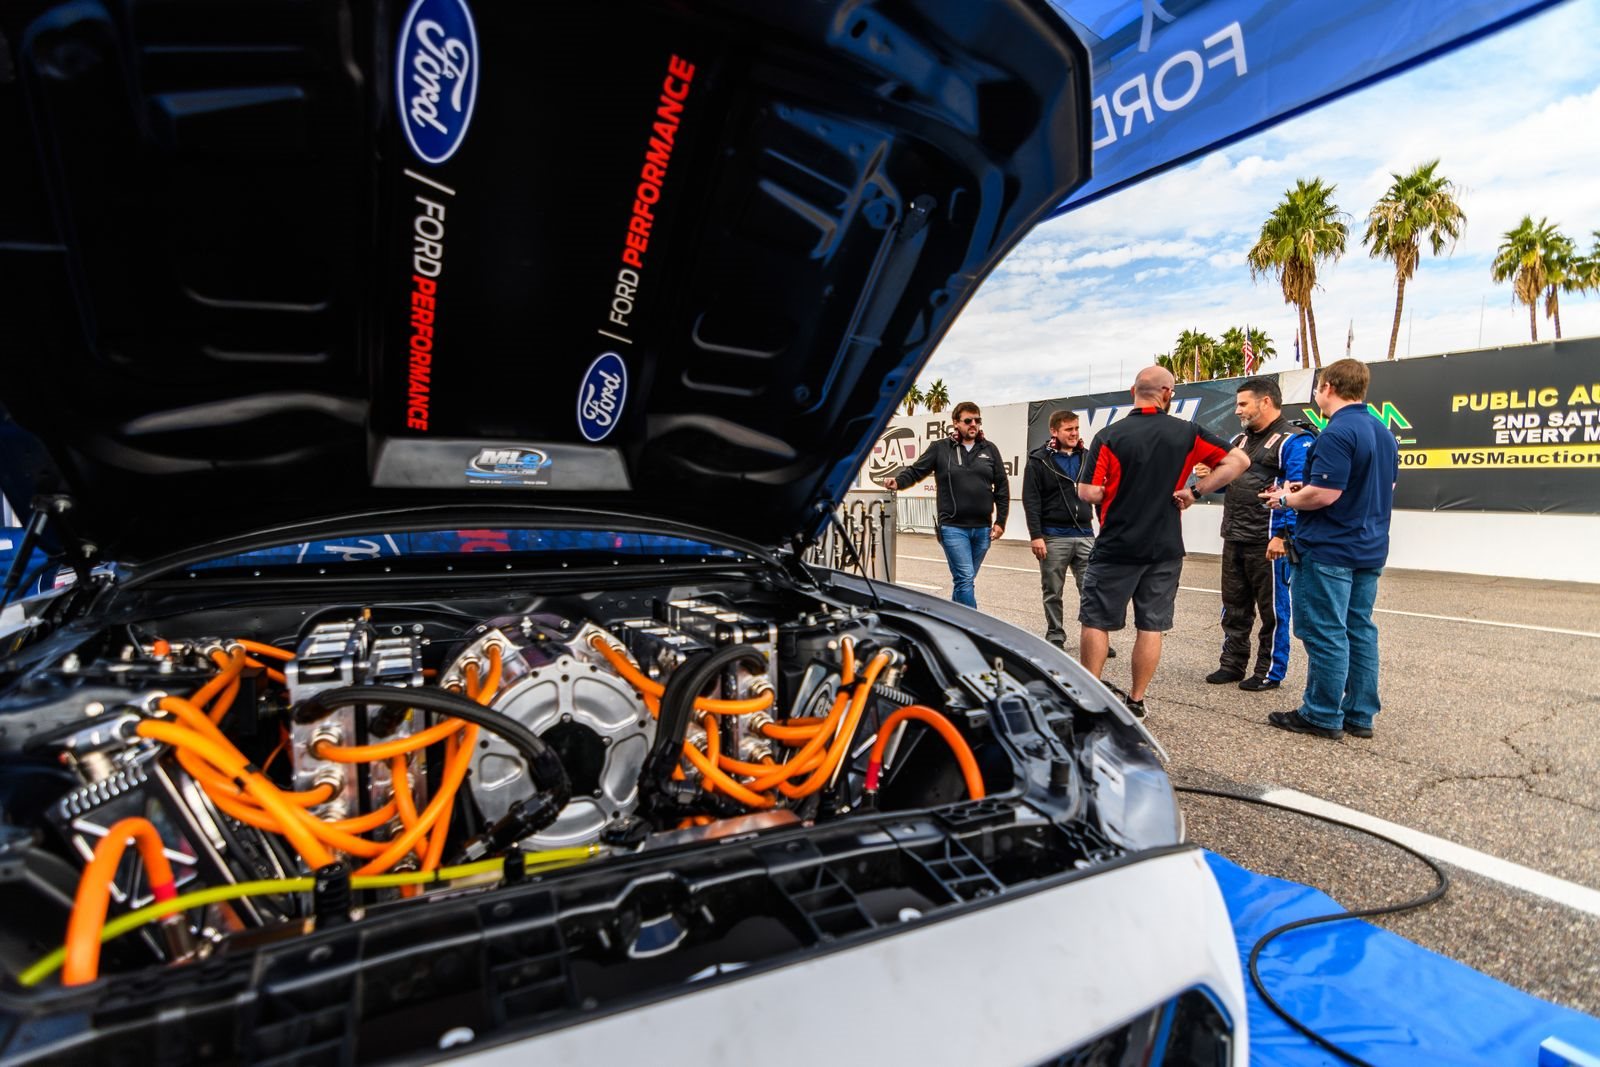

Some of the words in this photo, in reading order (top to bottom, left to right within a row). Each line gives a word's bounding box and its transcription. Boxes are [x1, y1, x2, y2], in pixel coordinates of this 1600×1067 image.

[411, 19, 470, 135] Ford
[622, 55, 695, 269] PERFORMANCE
[414, 196, 446, 278] FORD
[609, 268, 639, 327] FORD
[407, 274, 437, 431] PERFORMANCE
[582, 370, 621, 426] Ford
[1452, 386, 1559, 413] PUBLIC
[1492, 413, 1541, 430] 2ND
[1547, 410, 1600, 427] SAT
[869, 437, 918, 468] RAD
[1495, 427, 1577, 444] EVERY
